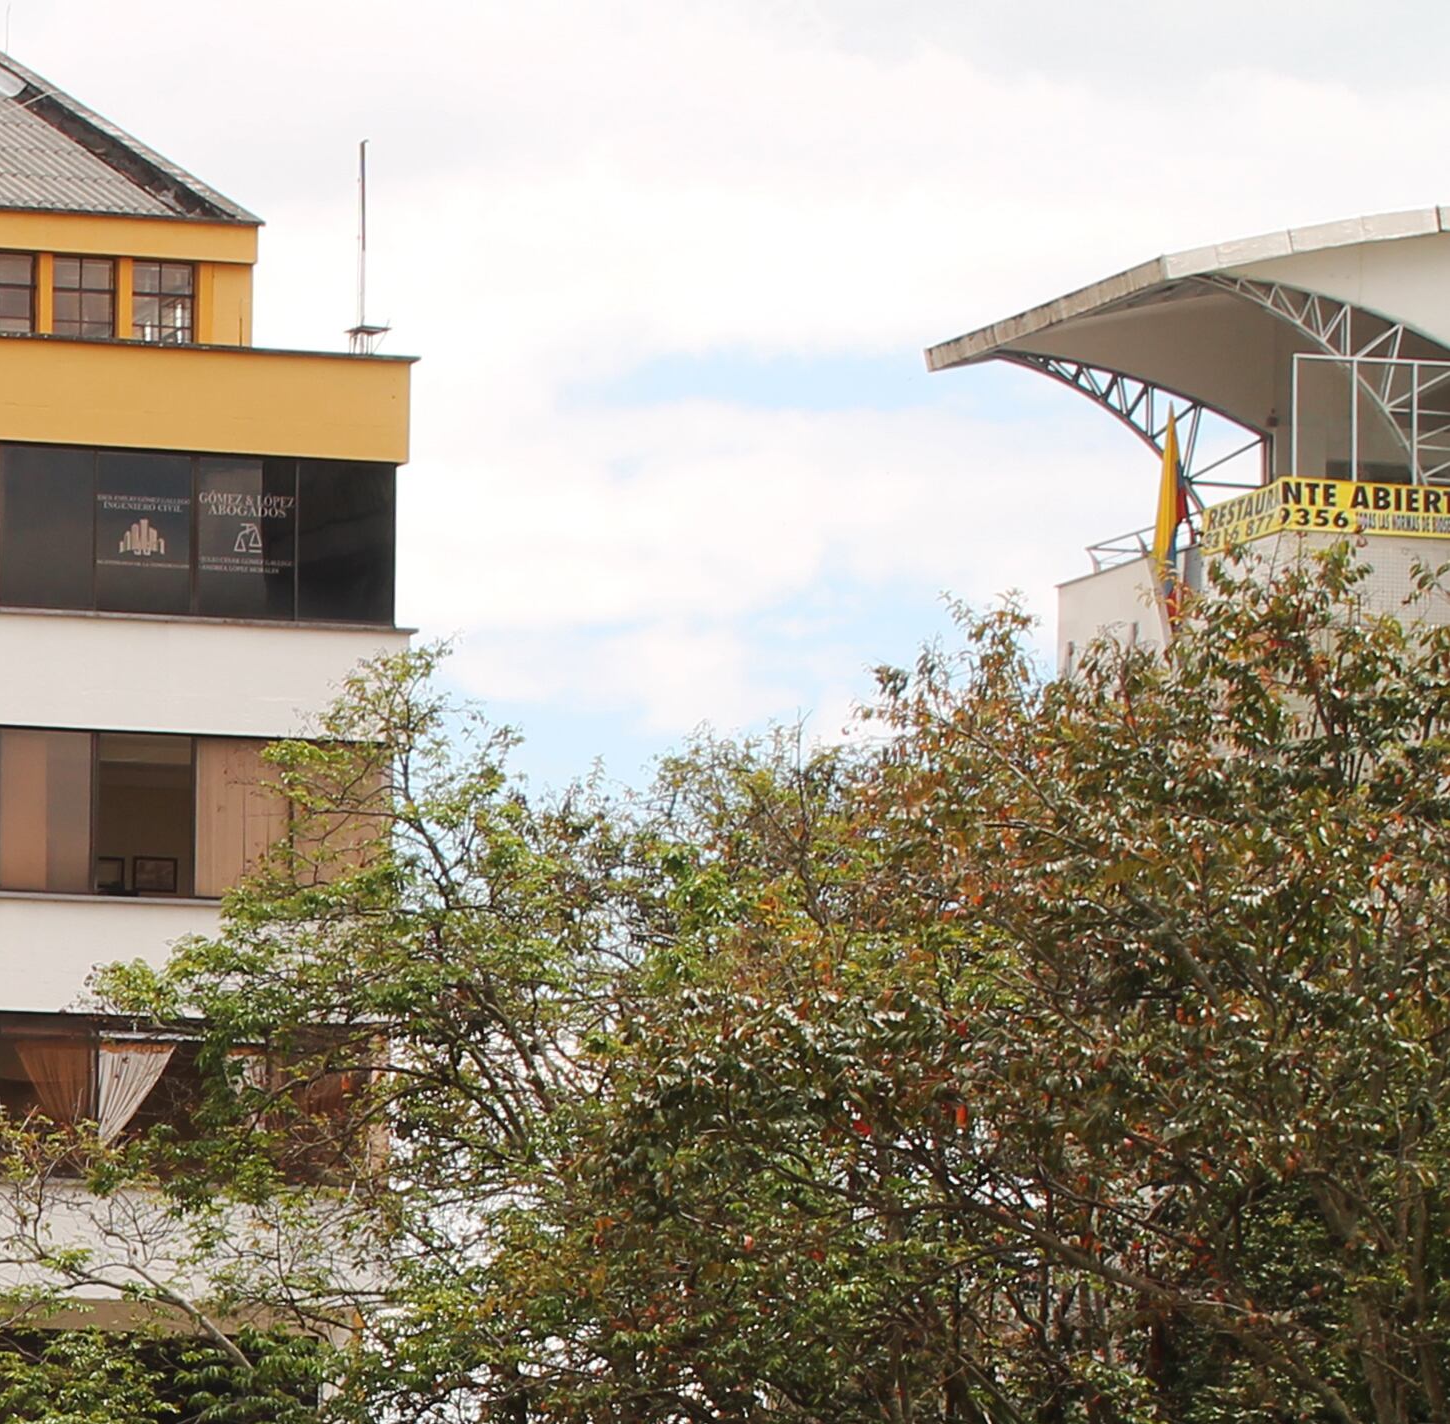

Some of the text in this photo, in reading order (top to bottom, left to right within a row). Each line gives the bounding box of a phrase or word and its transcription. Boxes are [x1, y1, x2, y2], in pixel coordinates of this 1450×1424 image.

[103, 500, 183, 513] INGENIERO CIVIL
[198, 489, 243, 505] GÓMEZ
[256, 493, 295, 508] LÓPEZ
[208, 503, 287, 519] ABOGADOS
